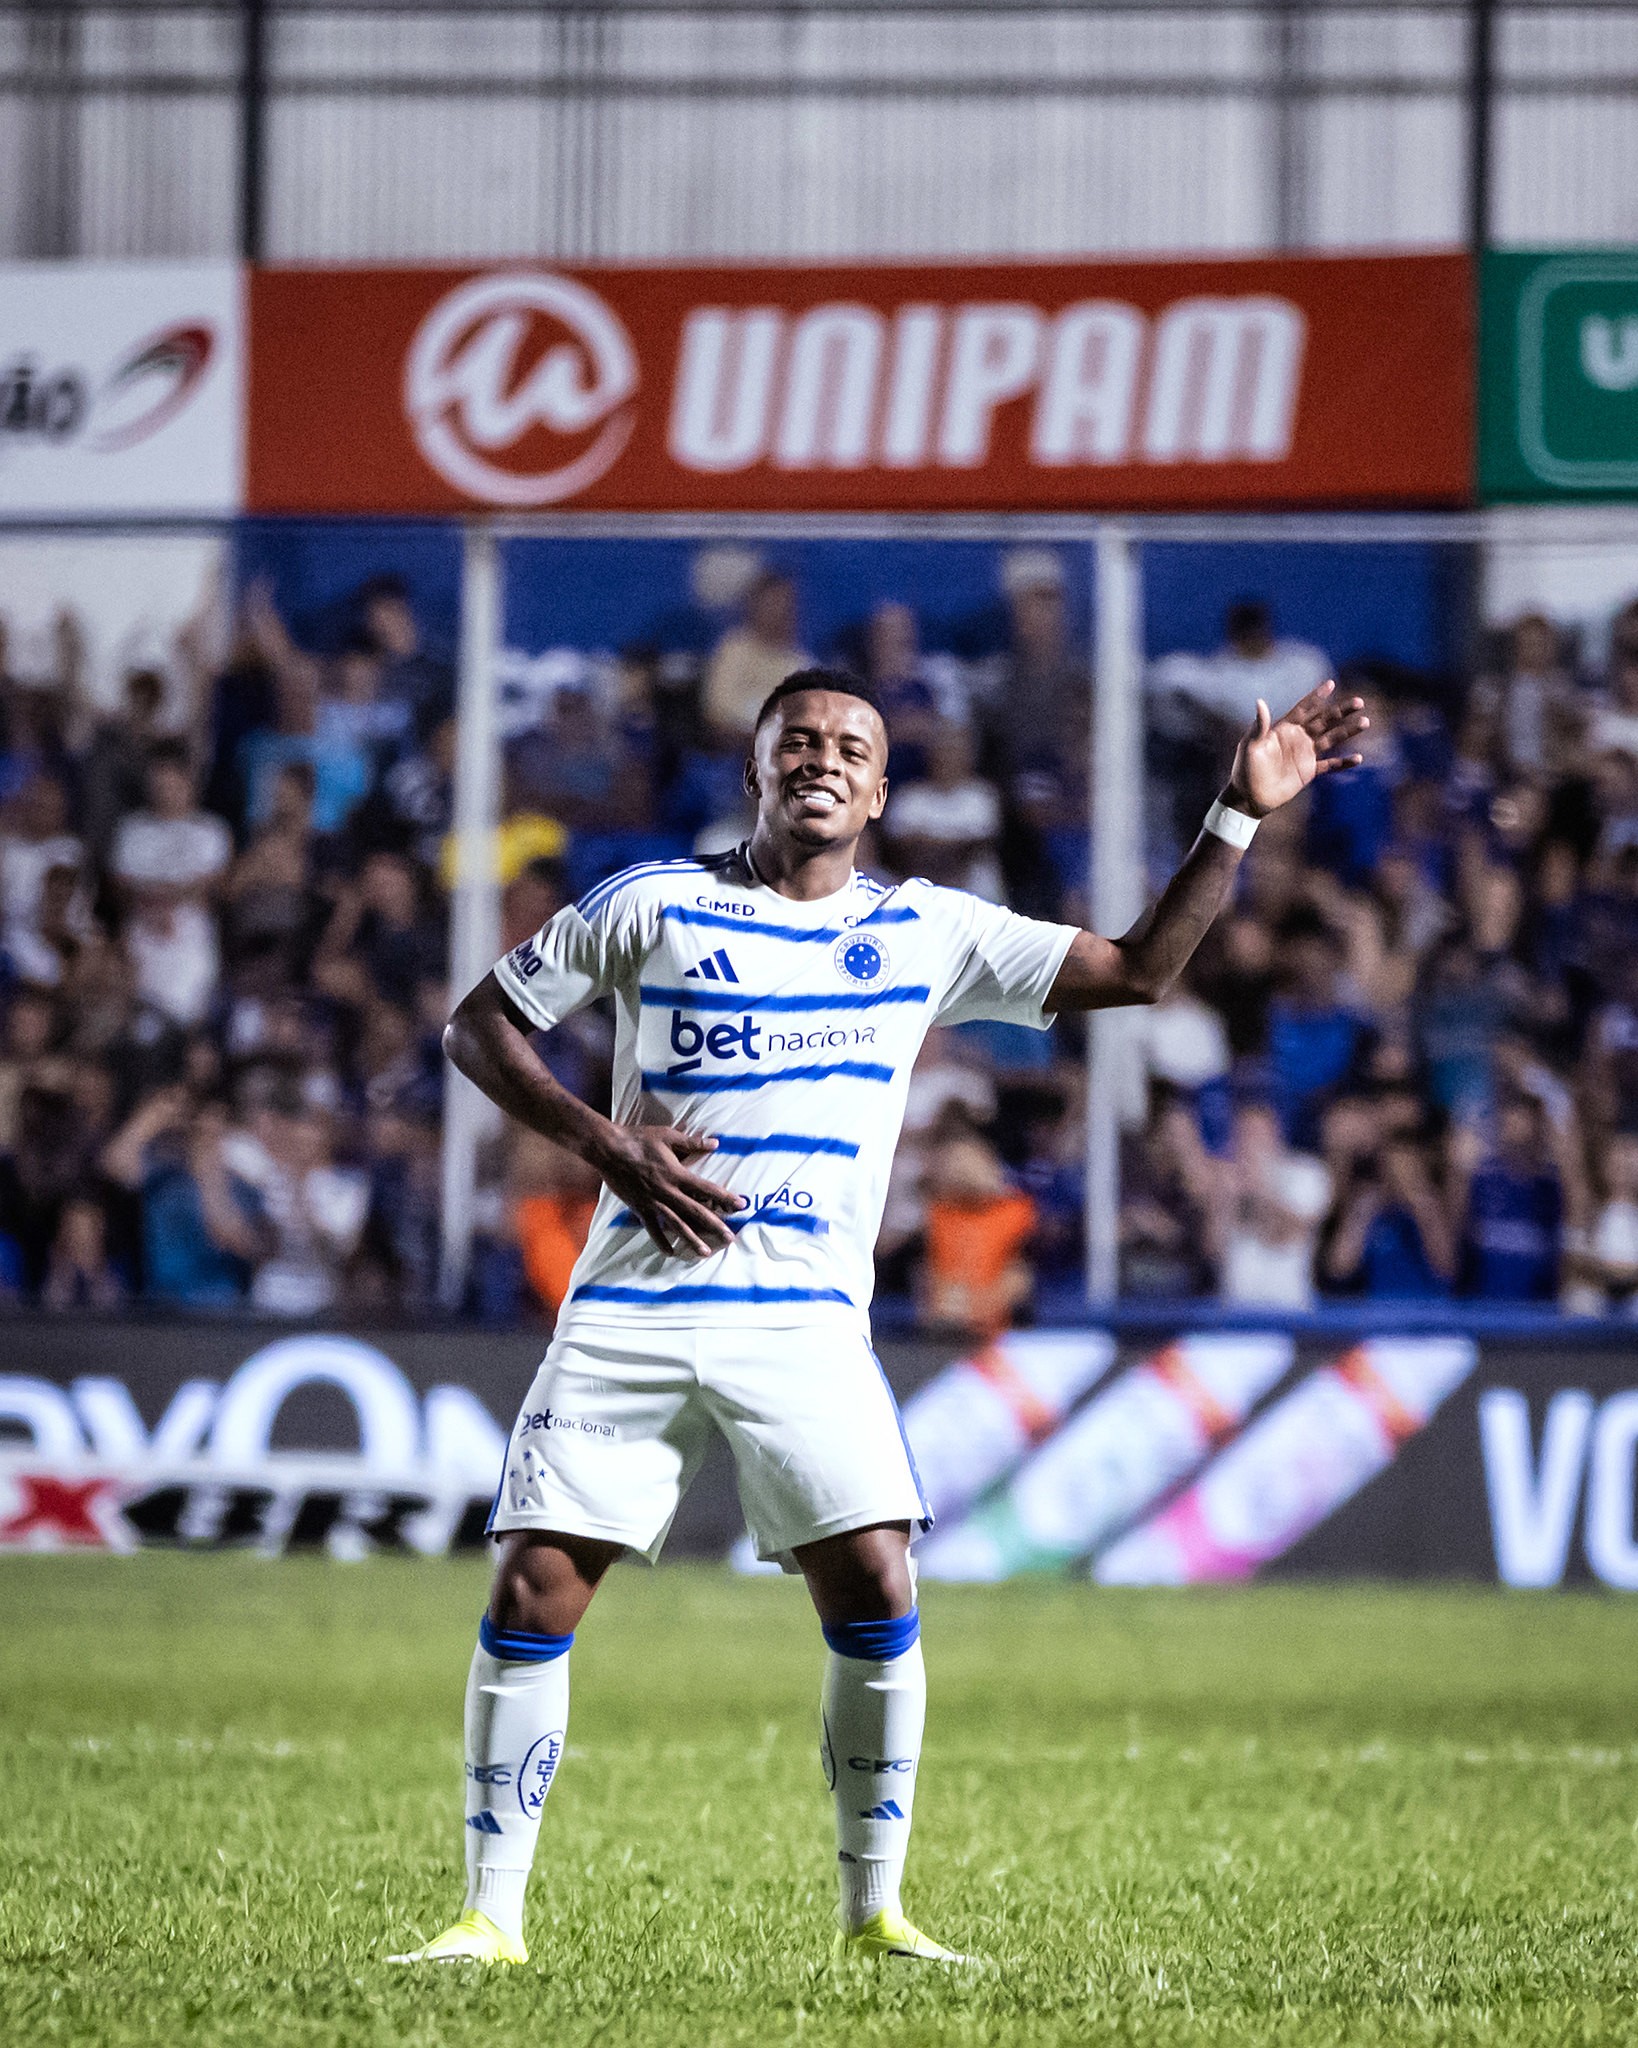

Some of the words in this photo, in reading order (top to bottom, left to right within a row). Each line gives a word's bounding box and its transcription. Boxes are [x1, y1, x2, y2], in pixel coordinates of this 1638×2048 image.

[668, 296, 1308, 472] UNIPAM
[696, 896, 755, 916] CIMED
[839, 935, 884, 953] CRUZEIRO
[768, 1025, 876, 1052] naciona
[528, 1738, 560, 1808] Kodilar
